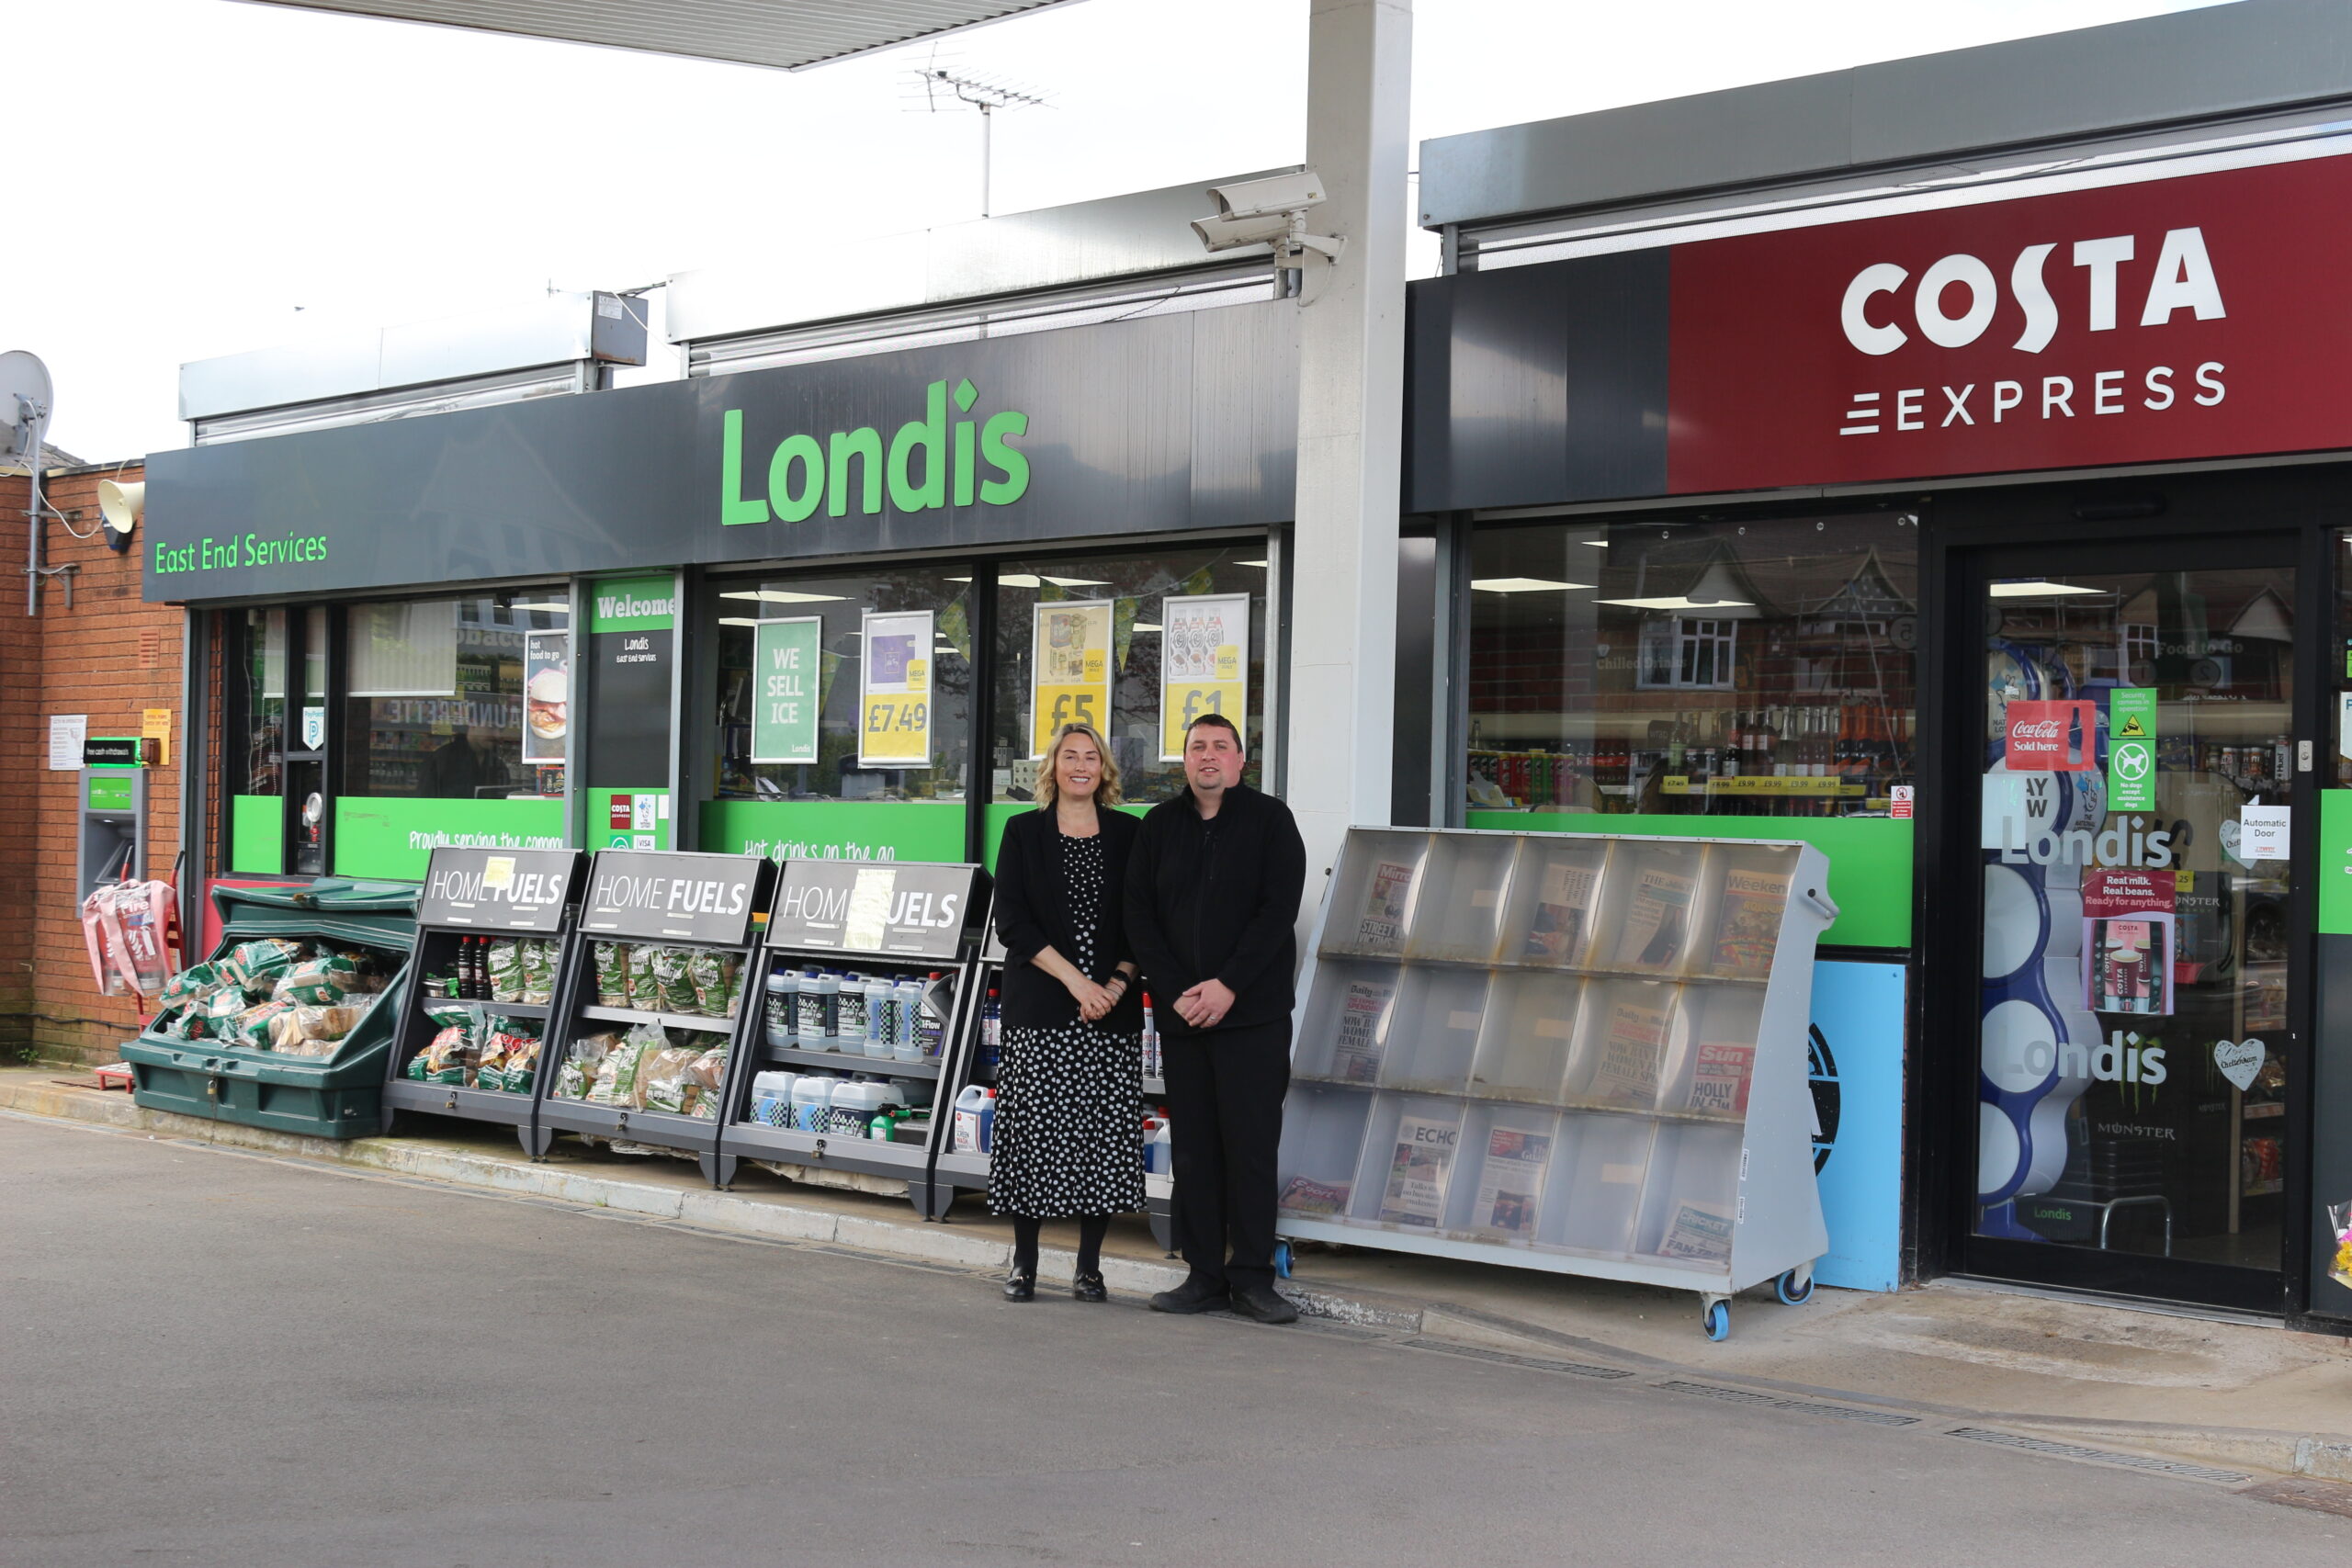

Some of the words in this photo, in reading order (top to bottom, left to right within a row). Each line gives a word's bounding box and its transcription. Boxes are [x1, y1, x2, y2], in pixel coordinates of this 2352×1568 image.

[1840, 226, 2227, 356] COSTA
[1896, 361, 2227, 431] EXPRESS
[721, 378, 1031, 526] Londis
[155, 542, 196, 573] East
[202, 535, 239, 570] End
[244, 531, 327, 567] Services
[597, 593, 675, 619] Welcome
[530, 640, 540, 649] hot
[625, 637, 649, 651] Londis
[2159, 641, 2196, 655] Food
[530, 649, 544, 660] food
[544, 651, 551, 660] to
[551, 651, 560, 661] go
[616, 654, 627, 663] East
[628, 653, 638, 662] End
[638, 652, 657, 662] Services
[773, 648, 800, 670] WE
[1217, 656, 1237, 665] MEGA
[1085, 660, 1102, 668] MEGA
[1596, 656, 1641, 671] Chilled
[909, 669, 925, 678] MEGA
[767, 675, 804, 697] SELL
[2120, 692, 2146, 700] Security
[771, 702, 799, 725] ICE
[867, 702, 927, 733] £7.49
[1050, 694, 1094, 736] £5
[1181, 690, 1222, 731] £1
[791, 743, 811, 753] Londis
[2014, 740, 2035, 751] Sold
[2037, 740, 2059, 751] here
[2026, 778, 2049, 796] AY
[611, 805, 630, 814] COSTA
[2243, 818, 2287, 828] Automatic
[409, 830, 450, 850] Proudly
[454, 831, 496, 848] serving
[501, 832, 521, 848] the
[526, 836, 564, 849] comm
[2255, 829, 2276, 838] Door
[2001, 815, 2172, 868] Londis
[744, 839, 769, 855] Hot
[773, 839, 819, 862] drinks
[822, 844, 840, 859] on
[844, 841, 871, 860] the
[1380, 865, 1412, 881] Mirro
[2107, 875, 2127, 886] Real
[2129, 876, 2152, 886] milk.
[1728, 875, 1787, 894] Weeken
[2103, 886, 2123, 896] Real
[2125, 887, 2155, 897] beans.
[594, 875, 666, 909] HOME
[667, 879, 746, 916] FUELS
[2086, 897, 2113, 906] Ready
[2115, 897, 2129, 906] for
[2131, 897, 2174, 908] anything.
[2175, 896, 2221, 908] ONSTER
[783, 886, 854, 921] HOM
[887, 891, 958, 929] UELS
[2118, 924, 2139, 932] COSTA
[1351, 985, 1374, 998] Daily
[1616, 1007, 1639, 1023] Daily
[1342, 1025, 1370, 1038] WOME
[2221, 1055, 2258, 1069] Cheltenham
[1694, 1082, 1733, 1099] HOLLY
[2098, 1122, 2177, 1141] MONSTER
[2033, 1205, 2073, 1222] Londis
